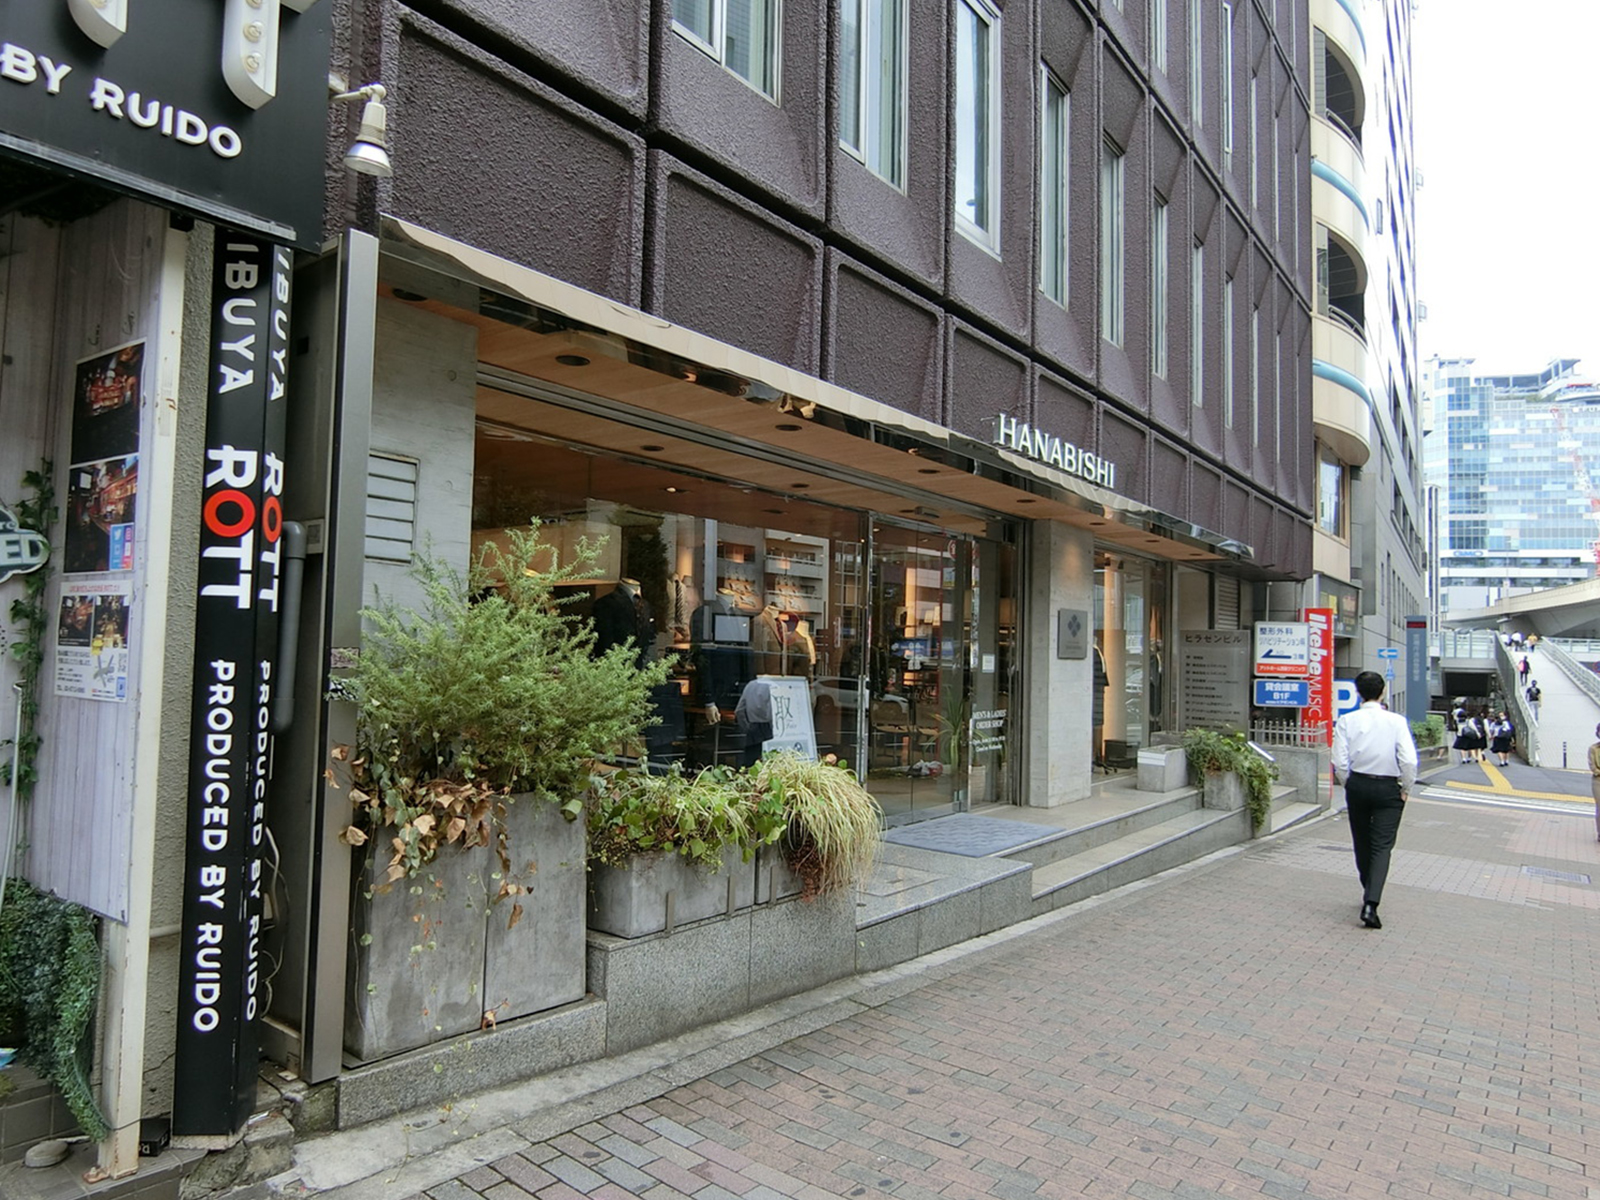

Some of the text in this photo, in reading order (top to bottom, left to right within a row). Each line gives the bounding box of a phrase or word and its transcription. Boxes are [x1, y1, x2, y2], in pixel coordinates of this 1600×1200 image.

[0, 42, 243, 158] BY RUIDO
[998, 412, 1115, 488] HANABISHI
[201, 444, 258, 609] ROTT
[245, 248, 291, 1022] IBUYA ROTT PRODUCED BY RUIDO
[1259, 627, 1293, 635] 整形外科
[1272, 692, 1291, 700] B1F
[1332, 680, 1358, 721] P
[199, 658, 236, 852] PRODUCED
[197, 864, 227, 910] BY
[192, 922, 223, 1033] RUIDO
